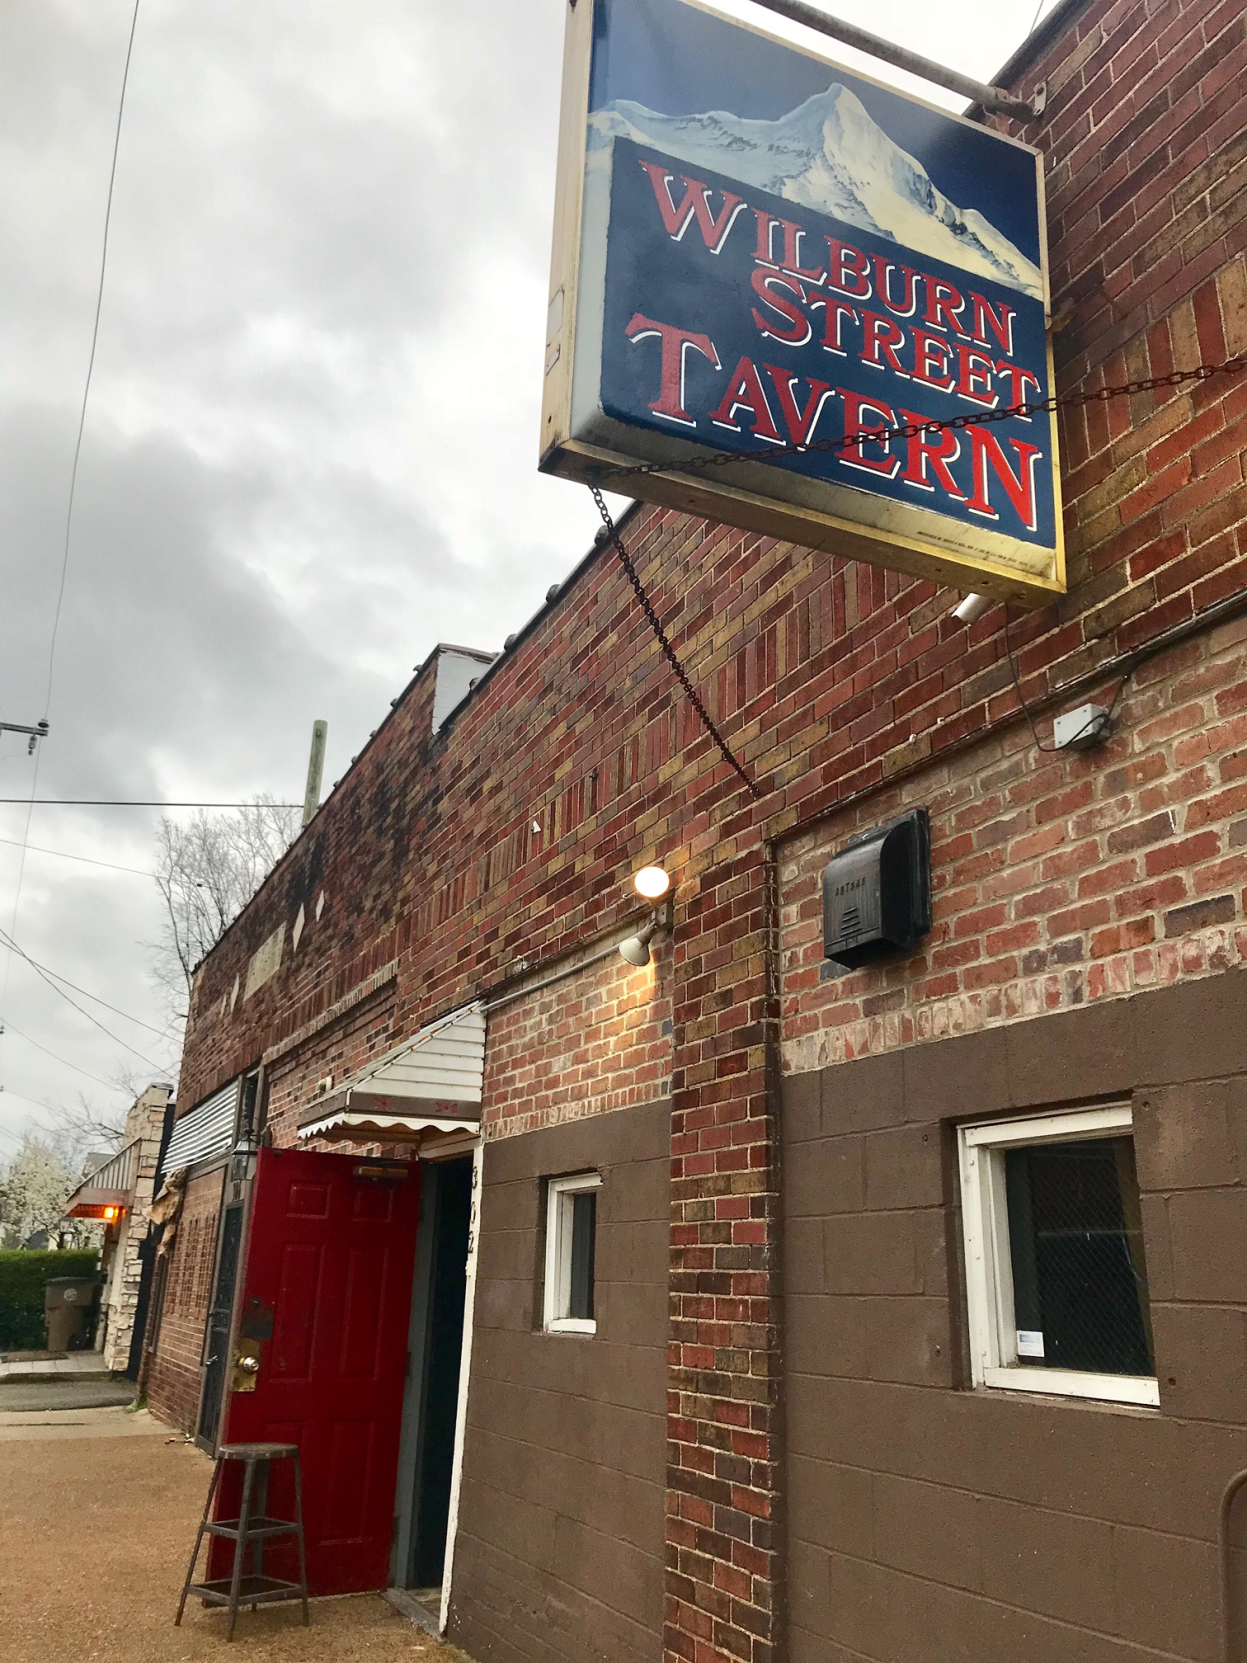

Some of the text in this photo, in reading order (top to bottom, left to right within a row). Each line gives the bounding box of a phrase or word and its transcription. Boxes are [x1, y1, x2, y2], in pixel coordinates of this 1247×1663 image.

[638, 159, 1017, 356] WILBURN
[751, 267, 1042, 422] STREET
[624, 312, 1043, 532] TAVERN
[468, 1166, 478, 1254] 302
